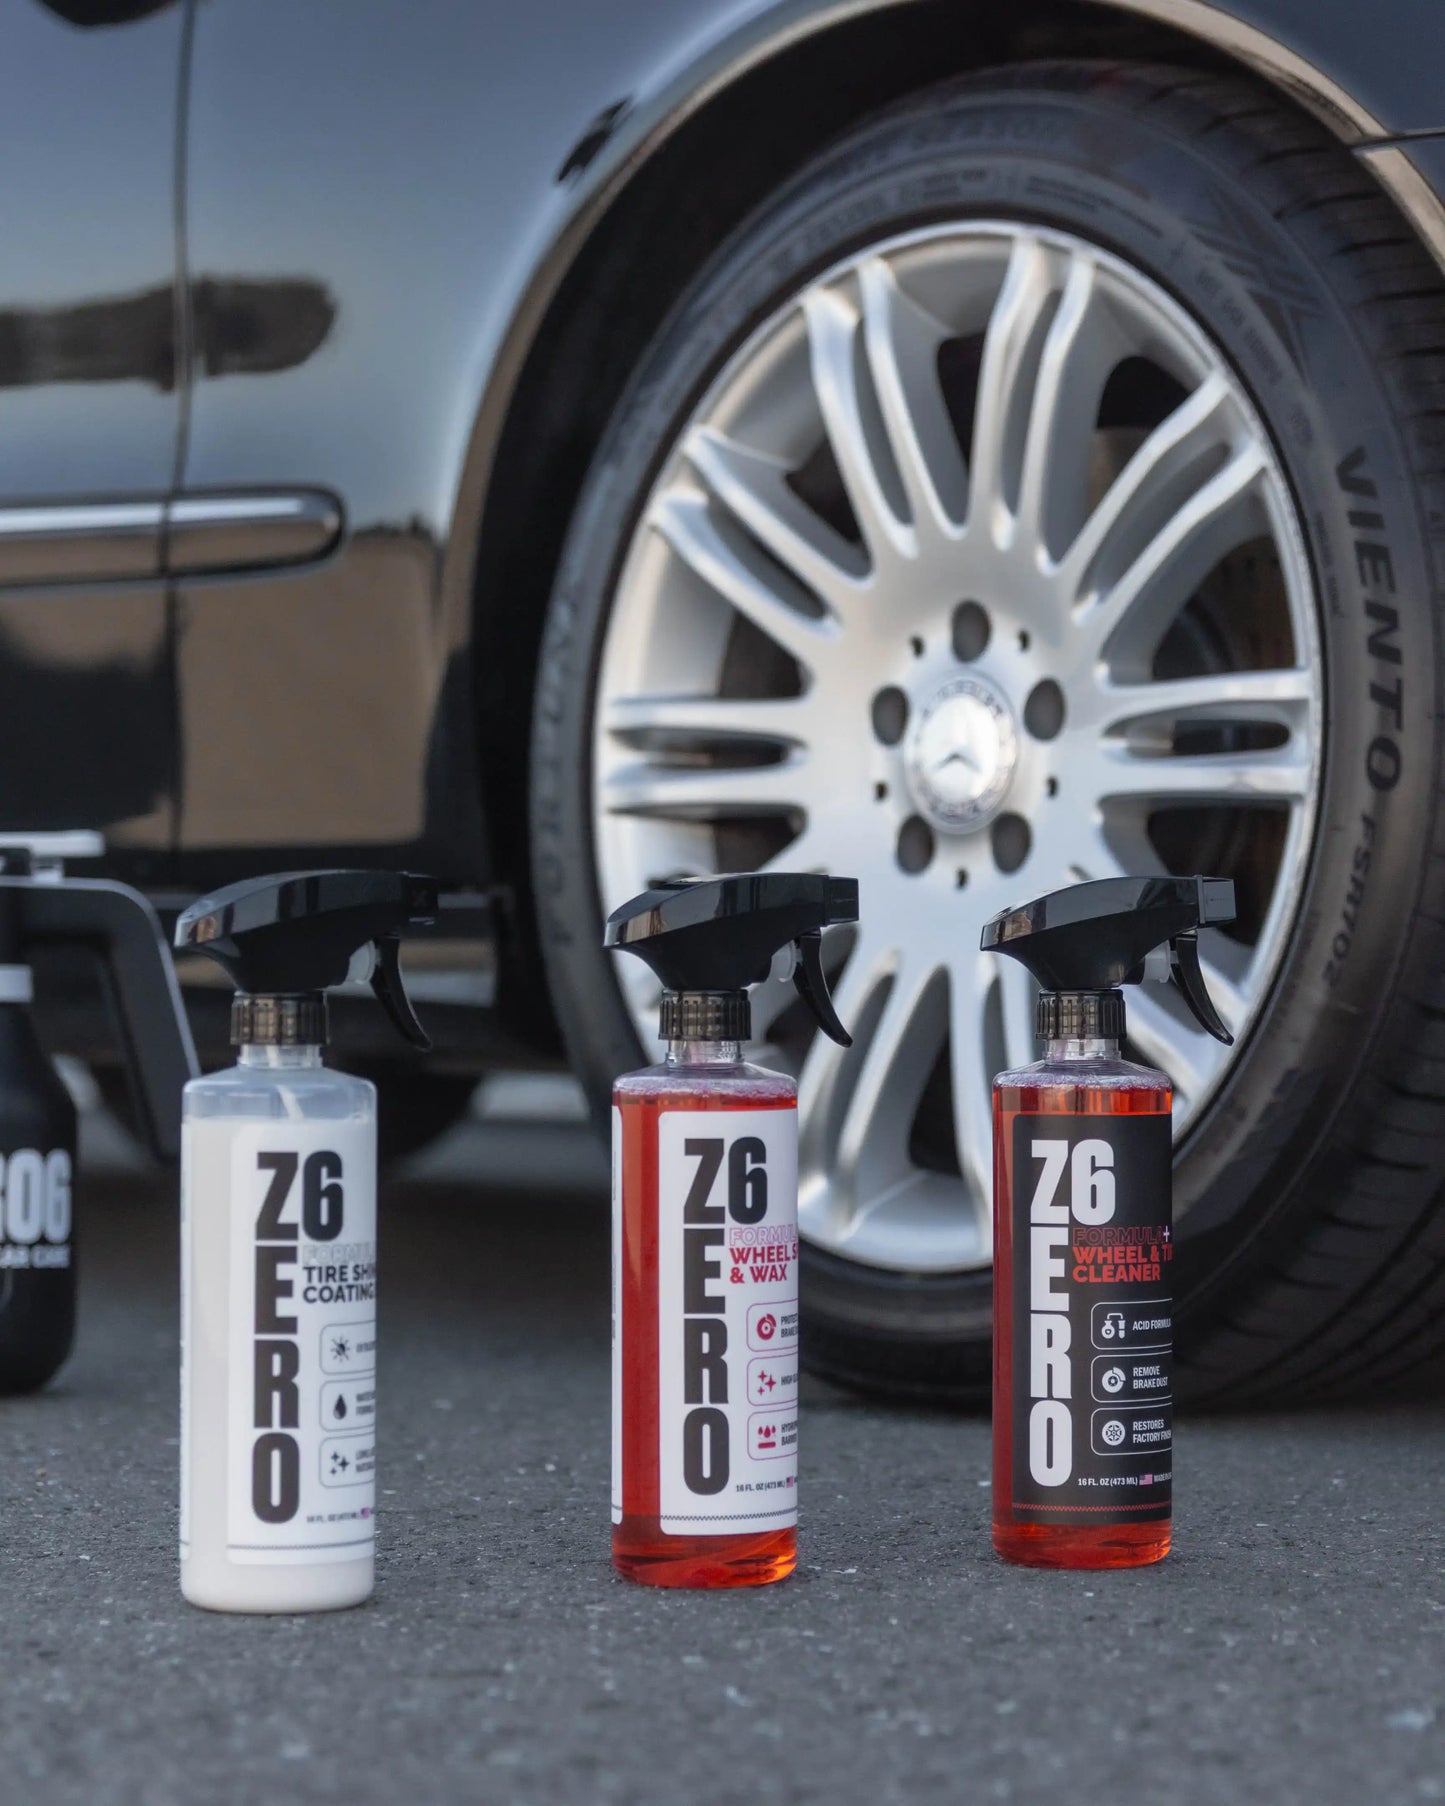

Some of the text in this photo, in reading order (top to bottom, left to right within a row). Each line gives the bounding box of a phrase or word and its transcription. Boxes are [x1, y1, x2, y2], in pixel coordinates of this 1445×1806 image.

[1336, 445, 1404, 792] VIENTO
[683, 1136, 769, 1226] Z6
[1029, 1138, 1117, 1227] Z6
[255, 1150, 345, 1243] Z6
[729, 1244, 791, 1265] WHEEL
[1072, 1245, 1148, 1265] WHEEL
[1149, 1245, 1161, 1263] &
[303, 1265, 348, 1284] TIRE
[729, 1263, 787, 1284] & WAX
[1072, 1263, 1161, 1284] CLEANER
[1132, 1320, 1150, 1331] ACID
[1133, 1366, 1160, 1376] REMOVE
[1133, 1376, 1168, 1389] BRAKE DUST
[1133, 1419, 1165, 1431] RESTORES
[1133, 1431, 1160, 1443] FACTORY
[736, 1484, 744, 1493] 16
[1077, 1478, 1087, 1486] 16
[1088, 1478, 1099, 1486] FL.
[1099, 1478, 1110, 1486] OZ
[1110, 1477, 1125, 1487] (473
[1126, 1476, 1138, 1486] ML)
